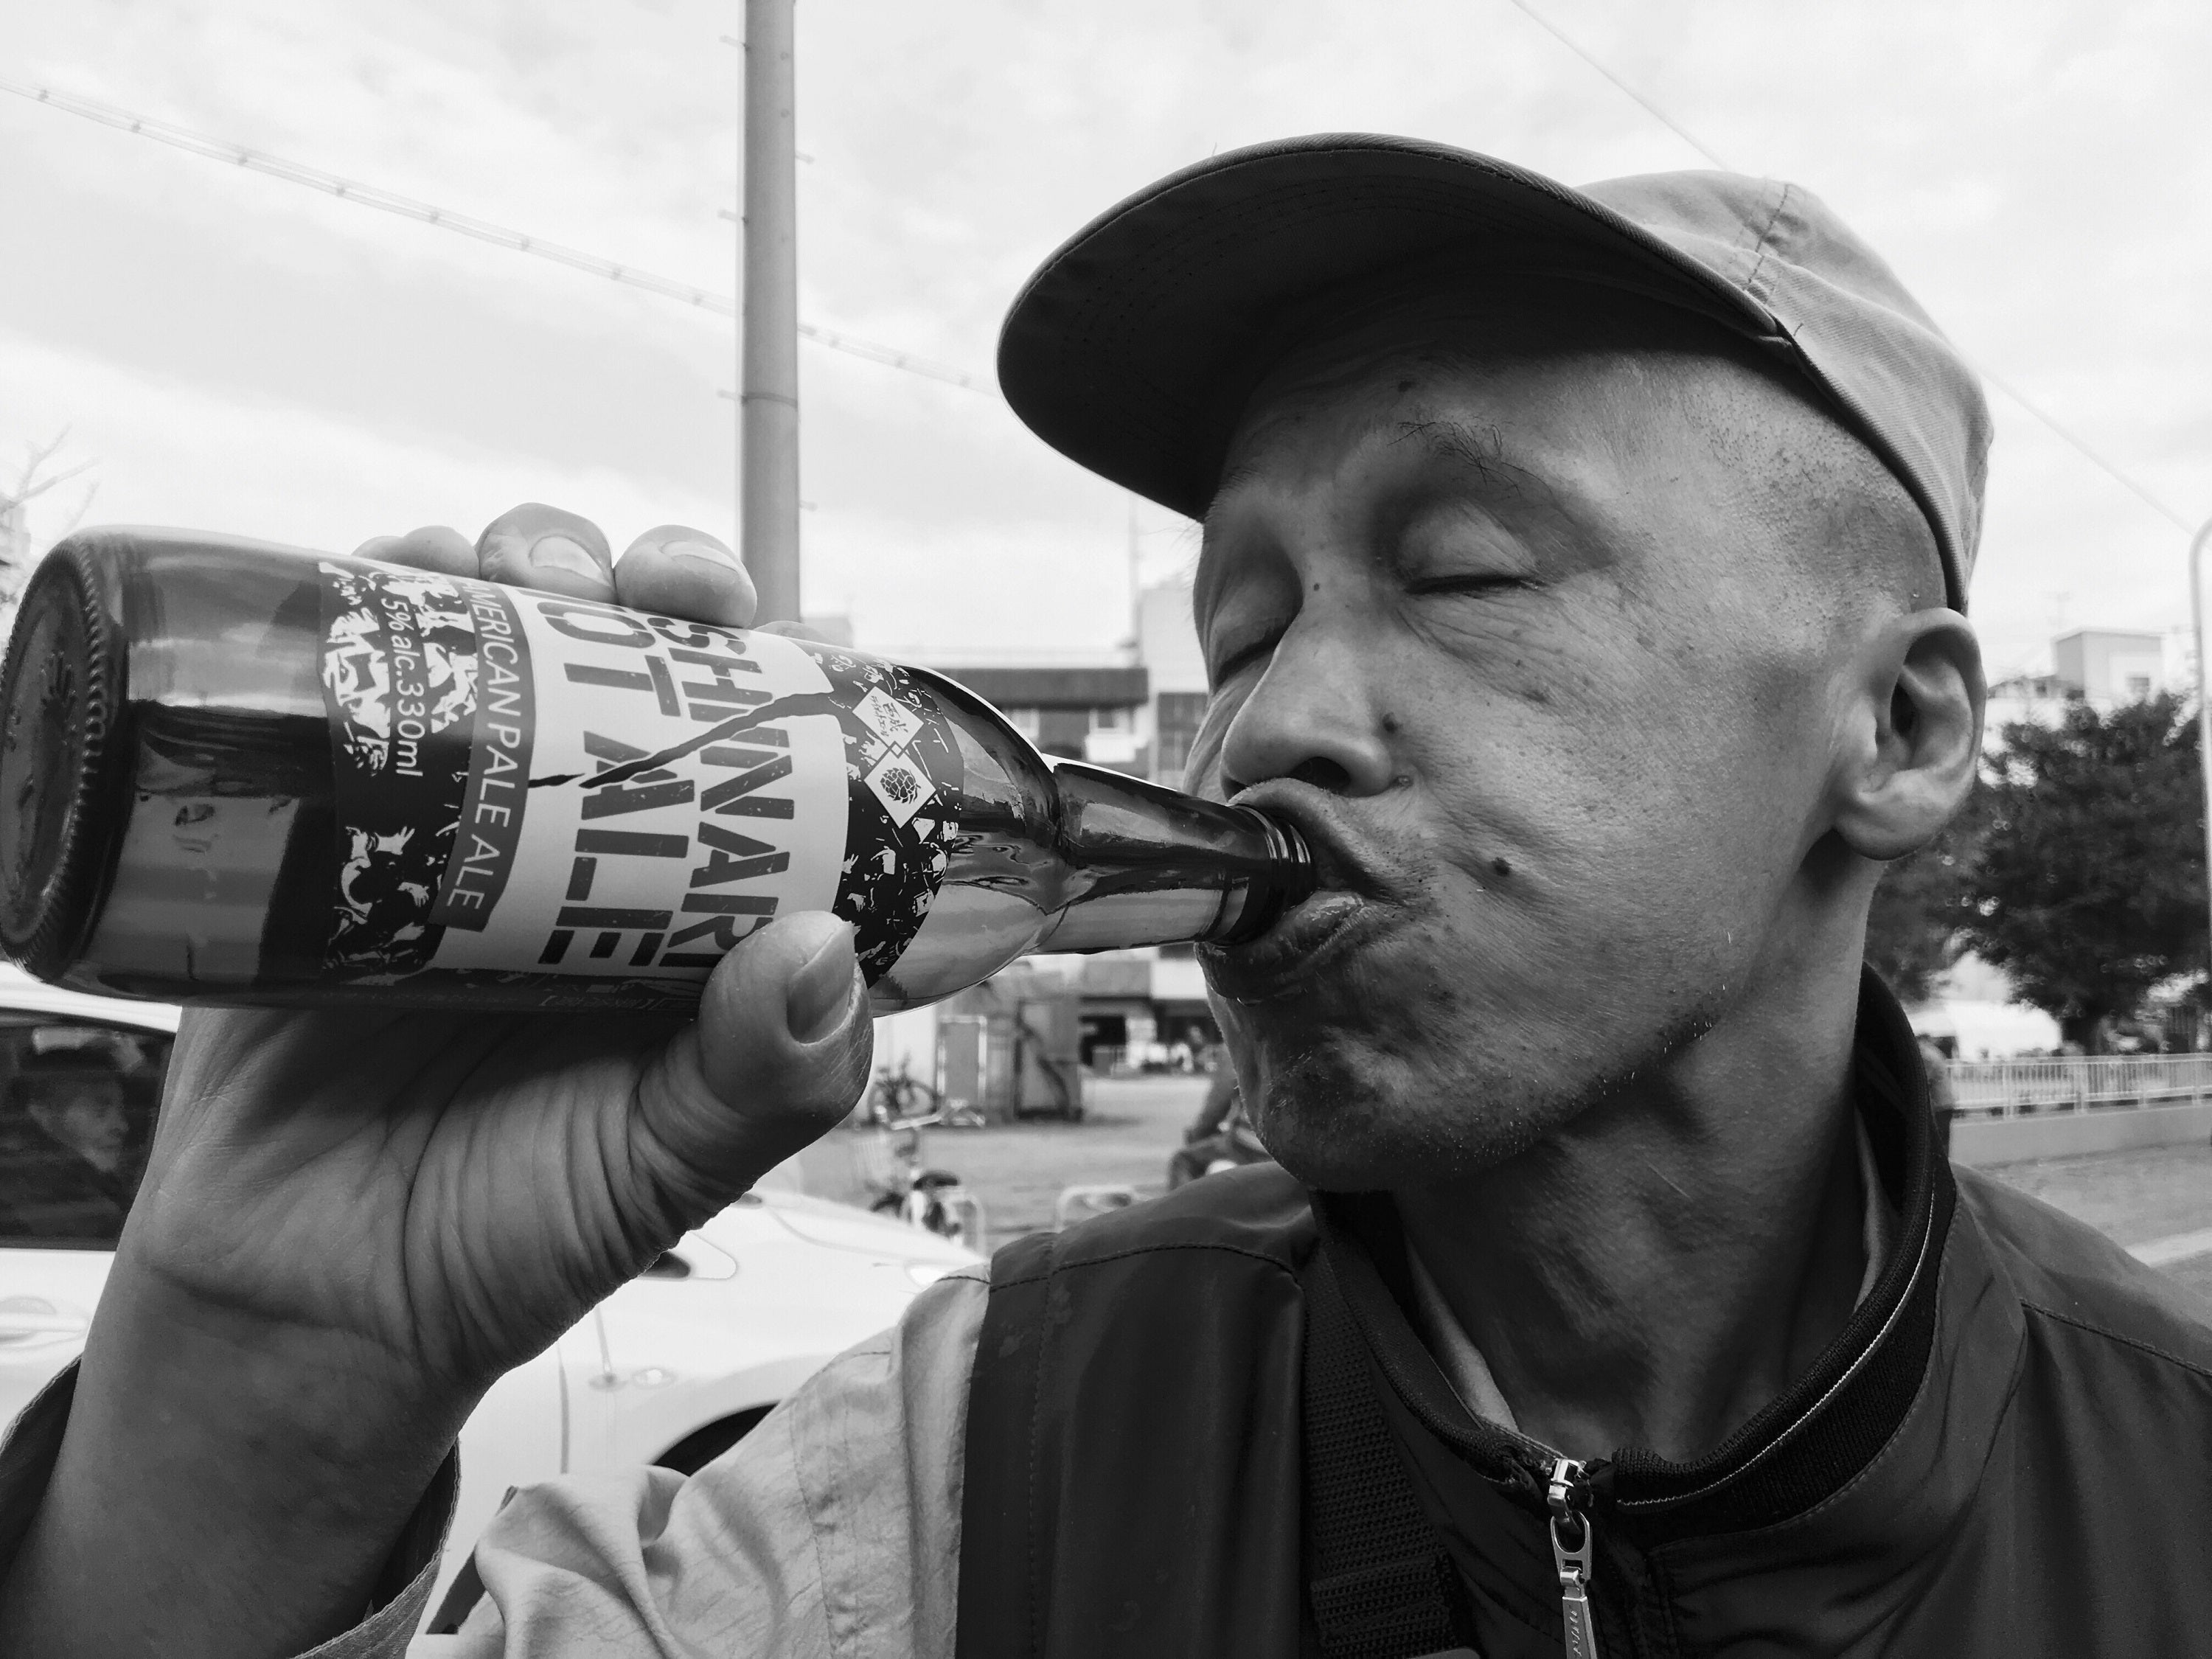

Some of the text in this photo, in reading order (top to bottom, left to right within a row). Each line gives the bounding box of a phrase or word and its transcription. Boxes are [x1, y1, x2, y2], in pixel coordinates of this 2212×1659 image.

[380, 598, 414, 631] 5%
[883, 703, 908, 733] 西成
[447, 580, 521, 910] AMERICAN PALE ALE
[538, 731, 695, 964] ALE
[632, 609, 794, 967] SHINARI
